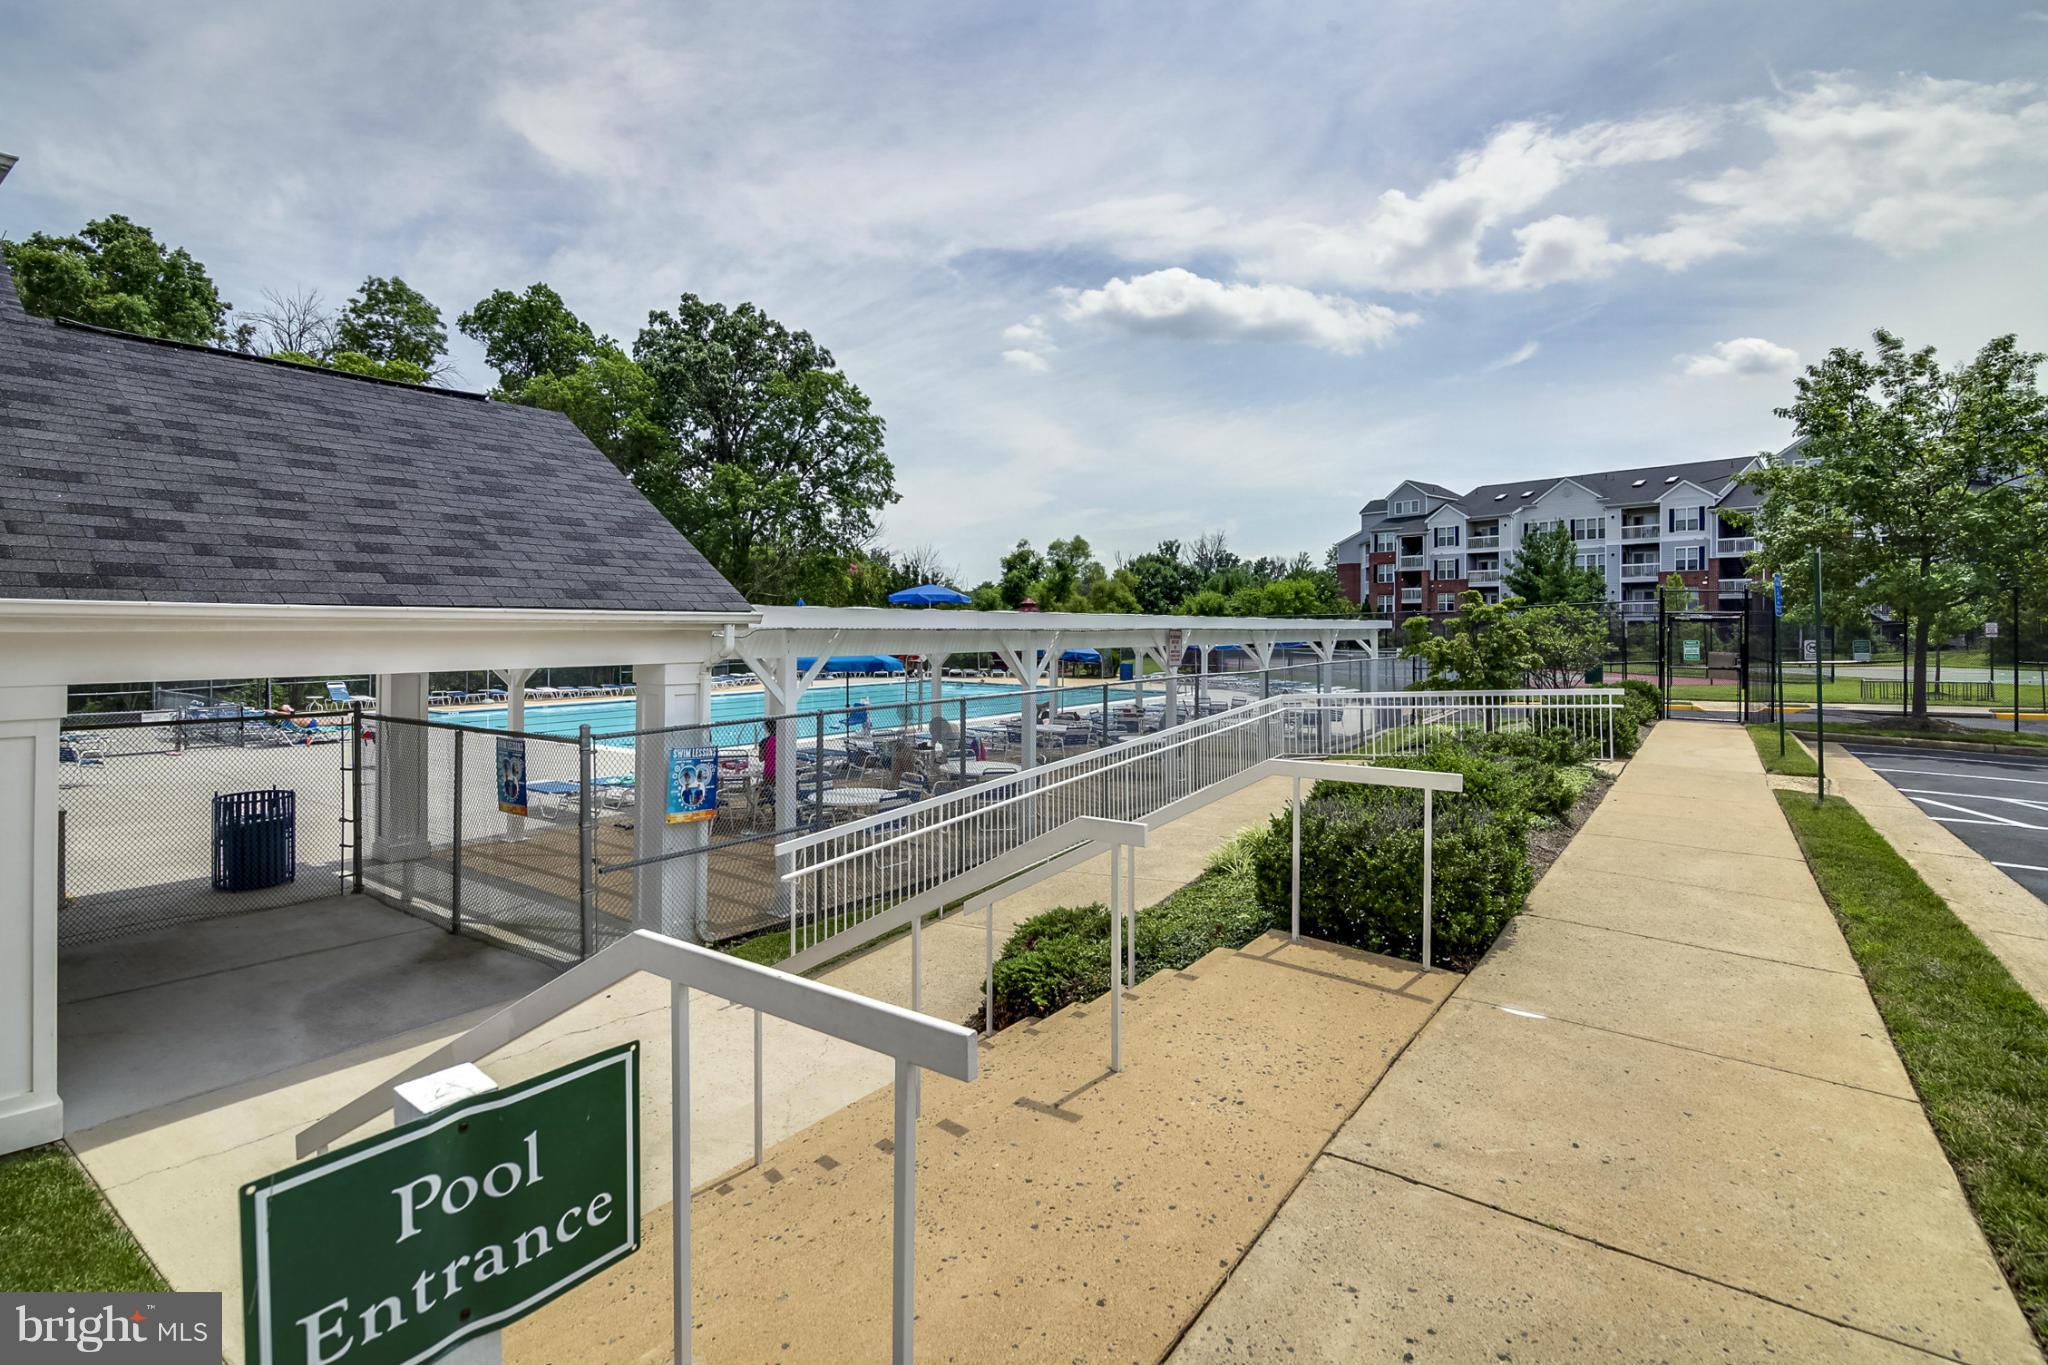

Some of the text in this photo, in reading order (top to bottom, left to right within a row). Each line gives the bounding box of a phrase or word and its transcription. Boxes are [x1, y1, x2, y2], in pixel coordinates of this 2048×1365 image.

[673, 748, 692, 759] SWIM
[391, 1129, 544, 1244] Pool
[295, 1191, 613, 1365] Entrance
